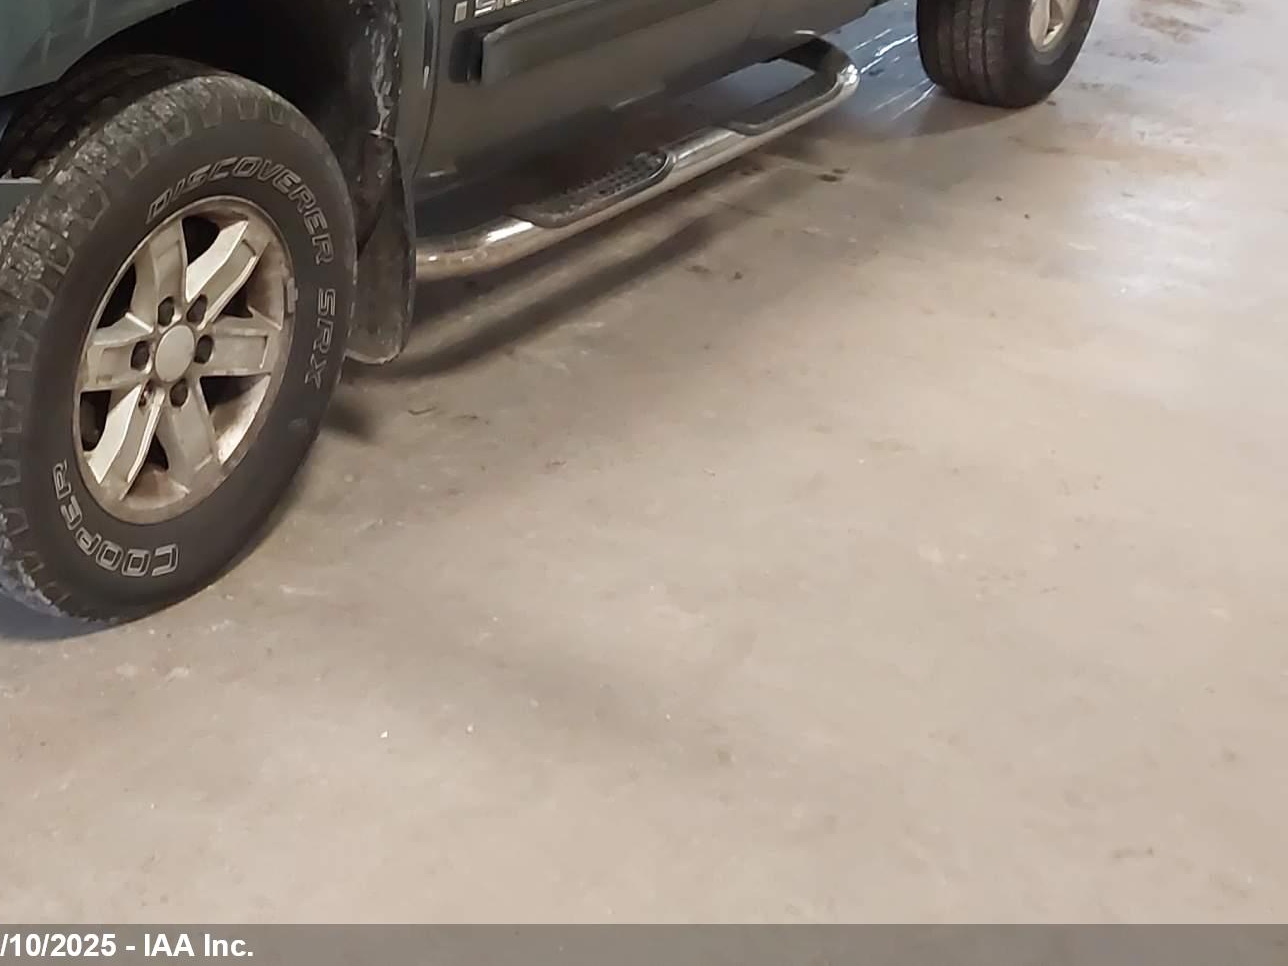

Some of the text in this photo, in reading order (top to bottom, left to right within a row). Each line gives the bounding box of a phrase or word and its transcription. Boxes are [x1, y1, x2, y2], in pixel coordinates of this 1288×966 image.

[146, 156, 336, 389] DISCOVERER SRX
[53, 459, 179, 577] COOPER
